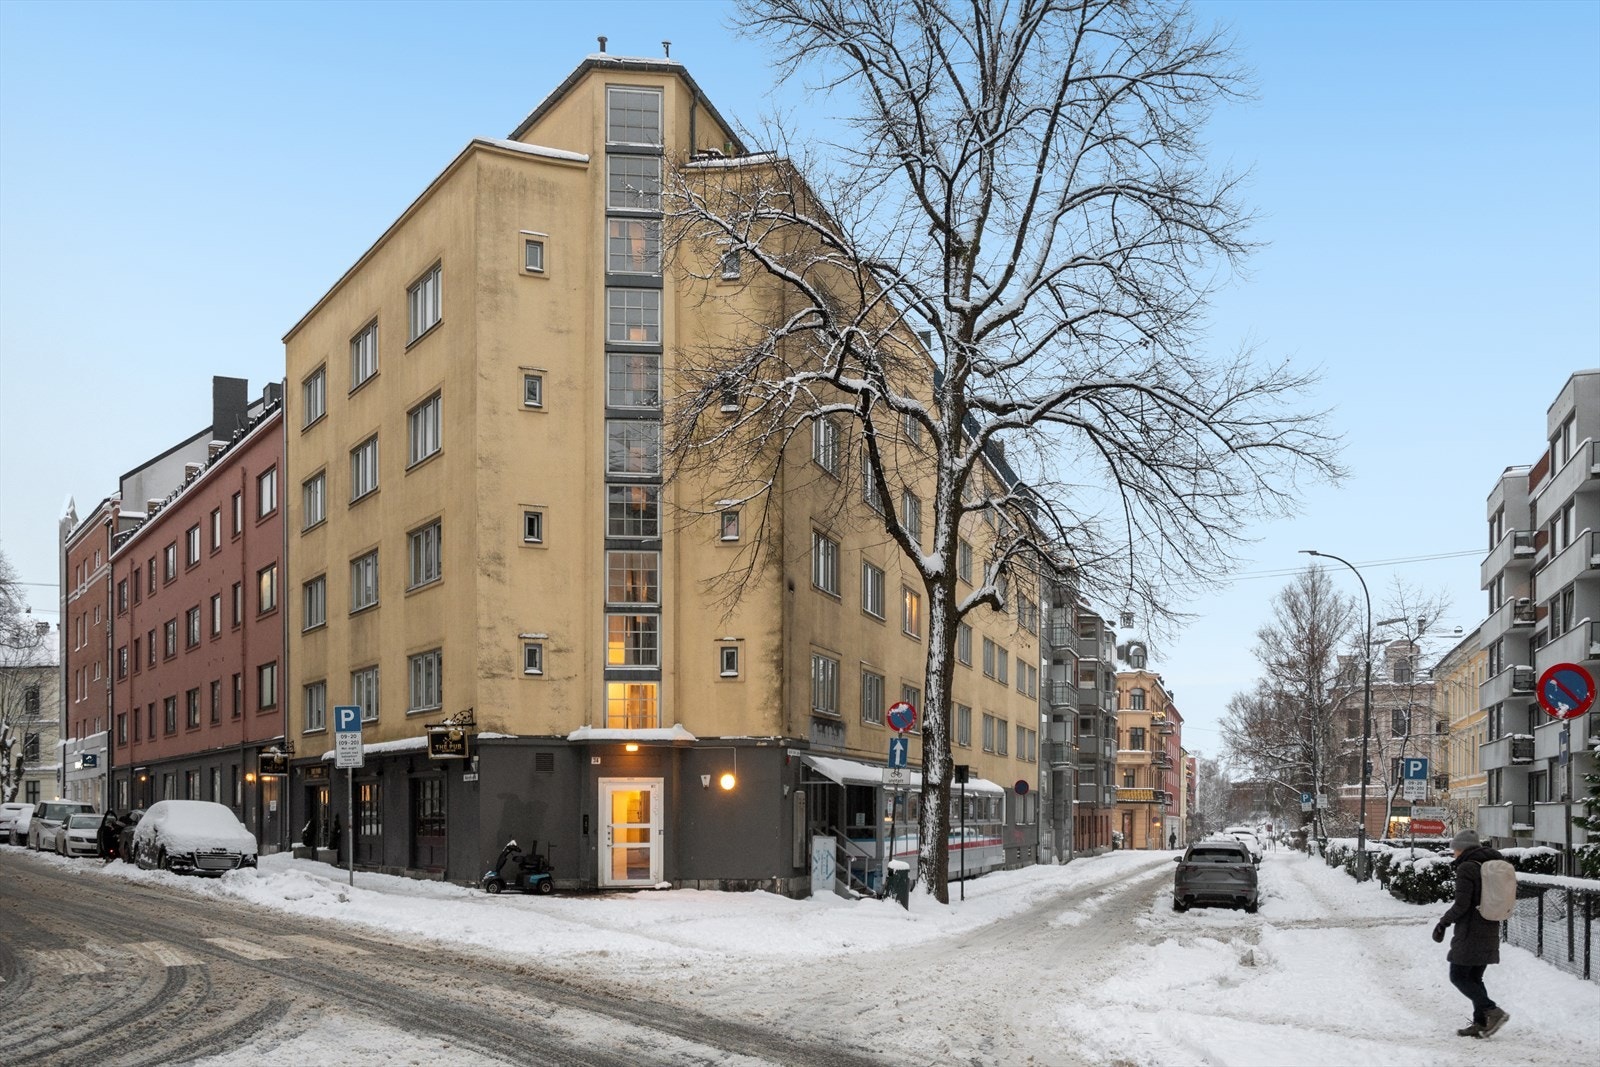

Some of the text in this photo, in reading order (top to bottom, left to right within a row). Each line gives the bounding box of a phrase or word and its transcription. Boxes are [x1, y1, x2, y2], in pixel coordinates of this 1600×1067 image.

[341, 709, 354, 729] P
[1409, 760, 1422, 777] P
[1302, 794, 1309, 802] P
